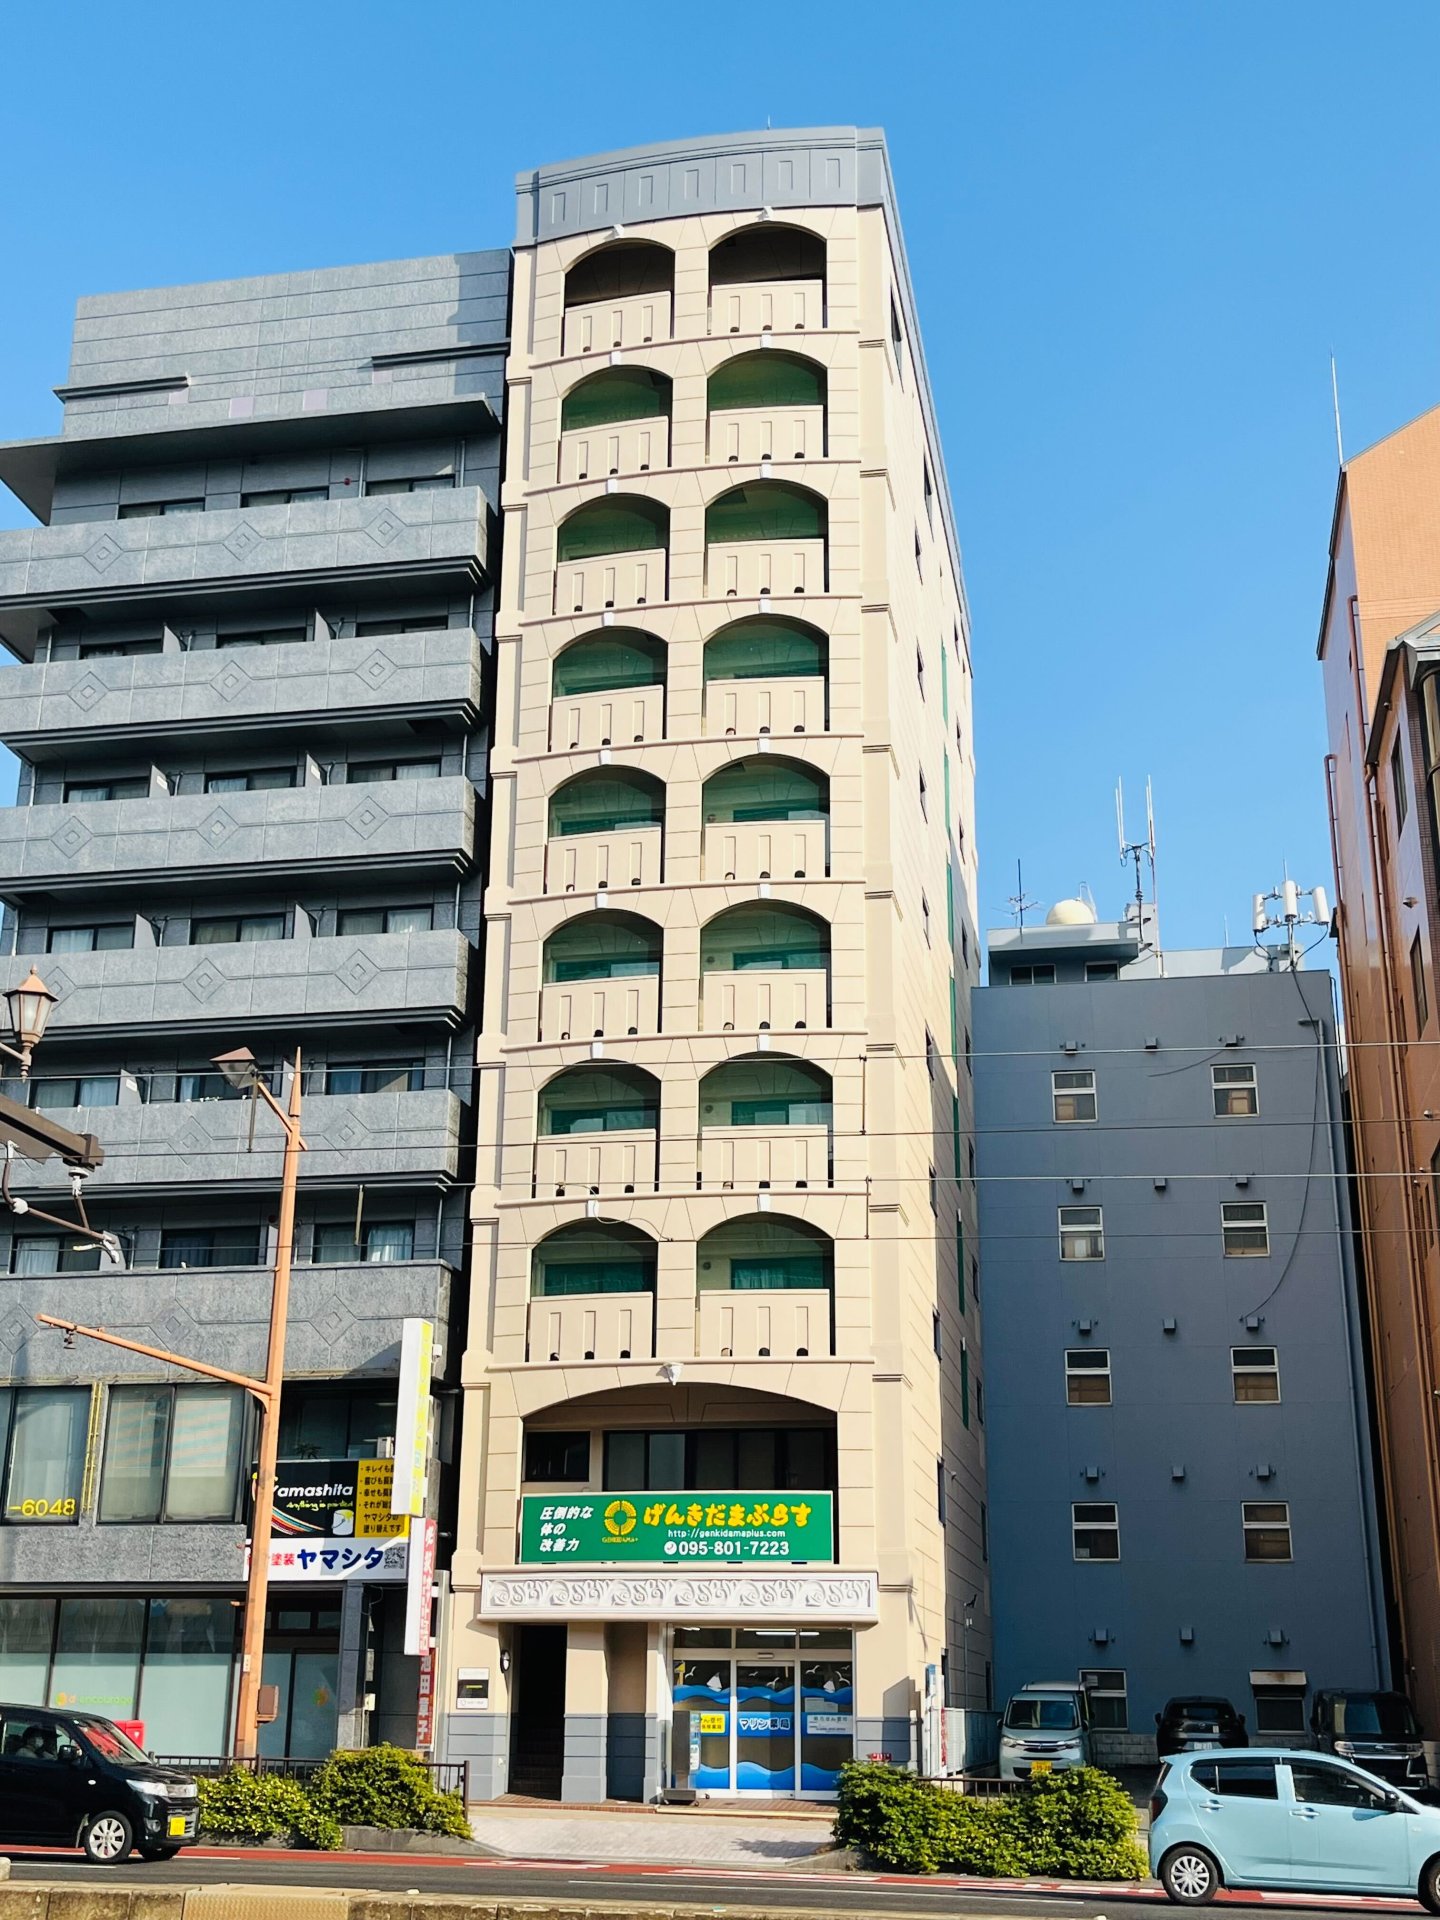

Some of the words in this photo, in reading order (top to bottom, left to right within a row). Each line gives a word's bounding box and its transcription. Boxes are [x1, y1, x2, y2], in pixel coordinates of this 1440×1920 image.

[540, 1505, 594, 1520] 圧倒的な
[643, 1502, 813, 1528] げんきだまぷらす
[540, 1522, 567, 1537] 体の
[667, 1527, 786, 1539] http://genkidamaplus.com
[540, 1537, 580, 1552] 改善力
[678, 1541, 790, 1556] 095-801-7223
[297, 1547, 384, 1570] ヤマシタ
[739, 1717, 790, 1731] マリン薬局
